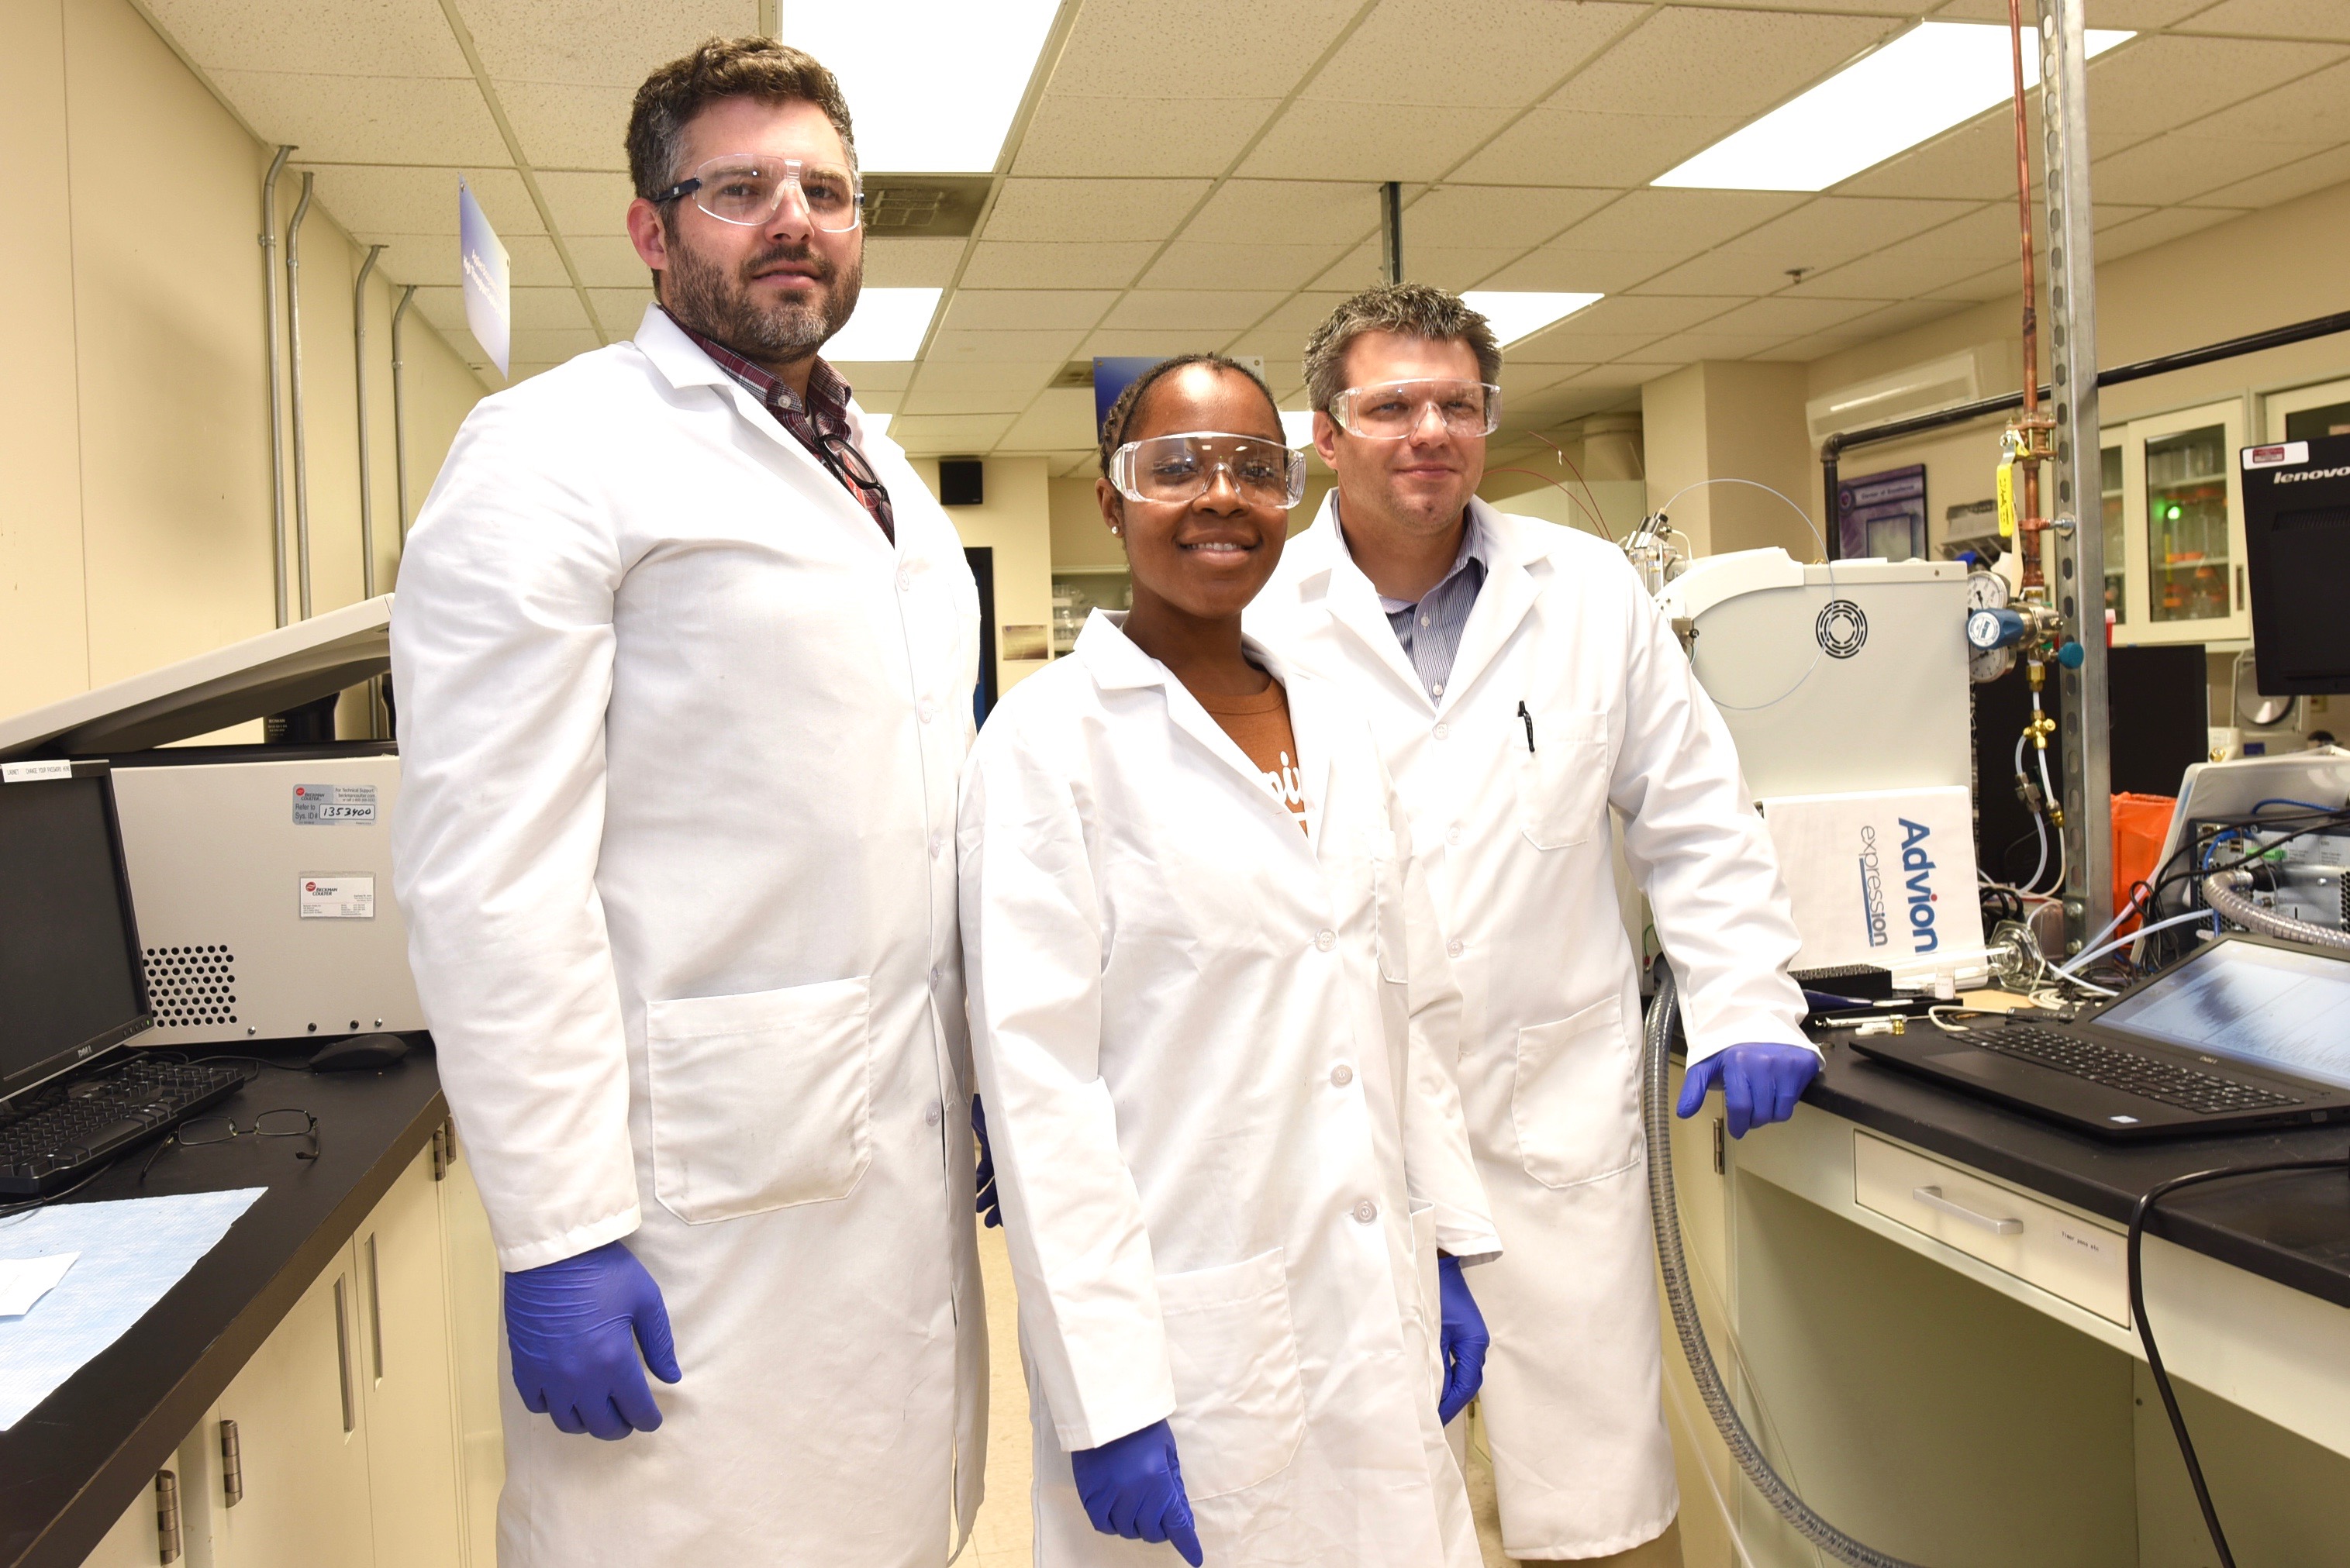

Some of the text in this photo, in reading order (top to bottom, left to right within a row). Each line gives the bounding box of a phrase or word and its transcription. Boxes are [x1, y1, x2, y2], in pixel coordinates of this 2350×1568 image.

[2273, 466, 2350, 484] lenovo
[323, 807, 371, 817] 1353400
[1858, 825, 1889, 946] expression
[1898, 817, 1938, 953] Advion
